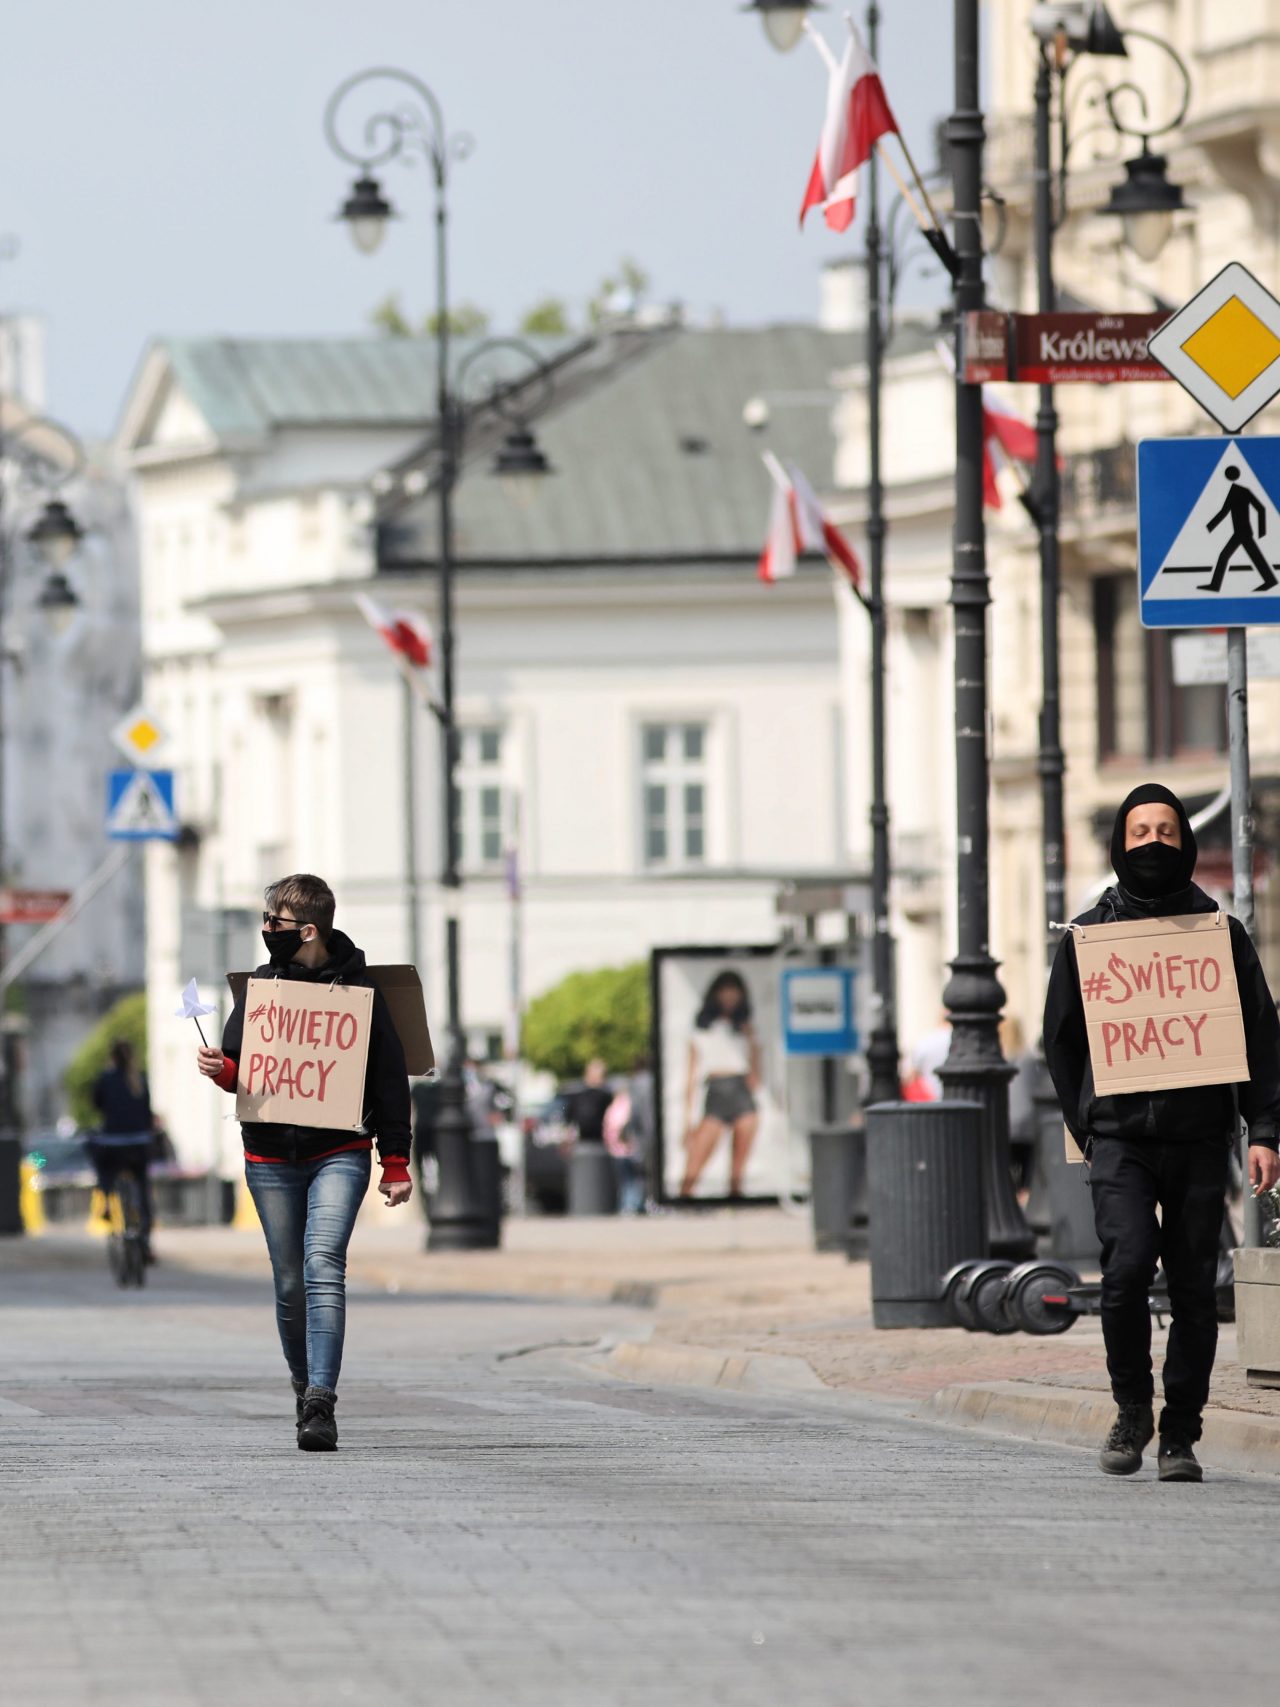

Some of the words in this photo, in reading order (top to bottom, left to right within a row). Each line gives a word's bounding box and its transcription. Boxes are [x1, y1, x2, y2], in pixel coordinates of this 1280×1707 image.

[248, 999, 358, 1051] #ŚWIĘTO
[1102, 1013, 1208, 1067] PRACY
[246, 1053, 337, 1102] PRACY
